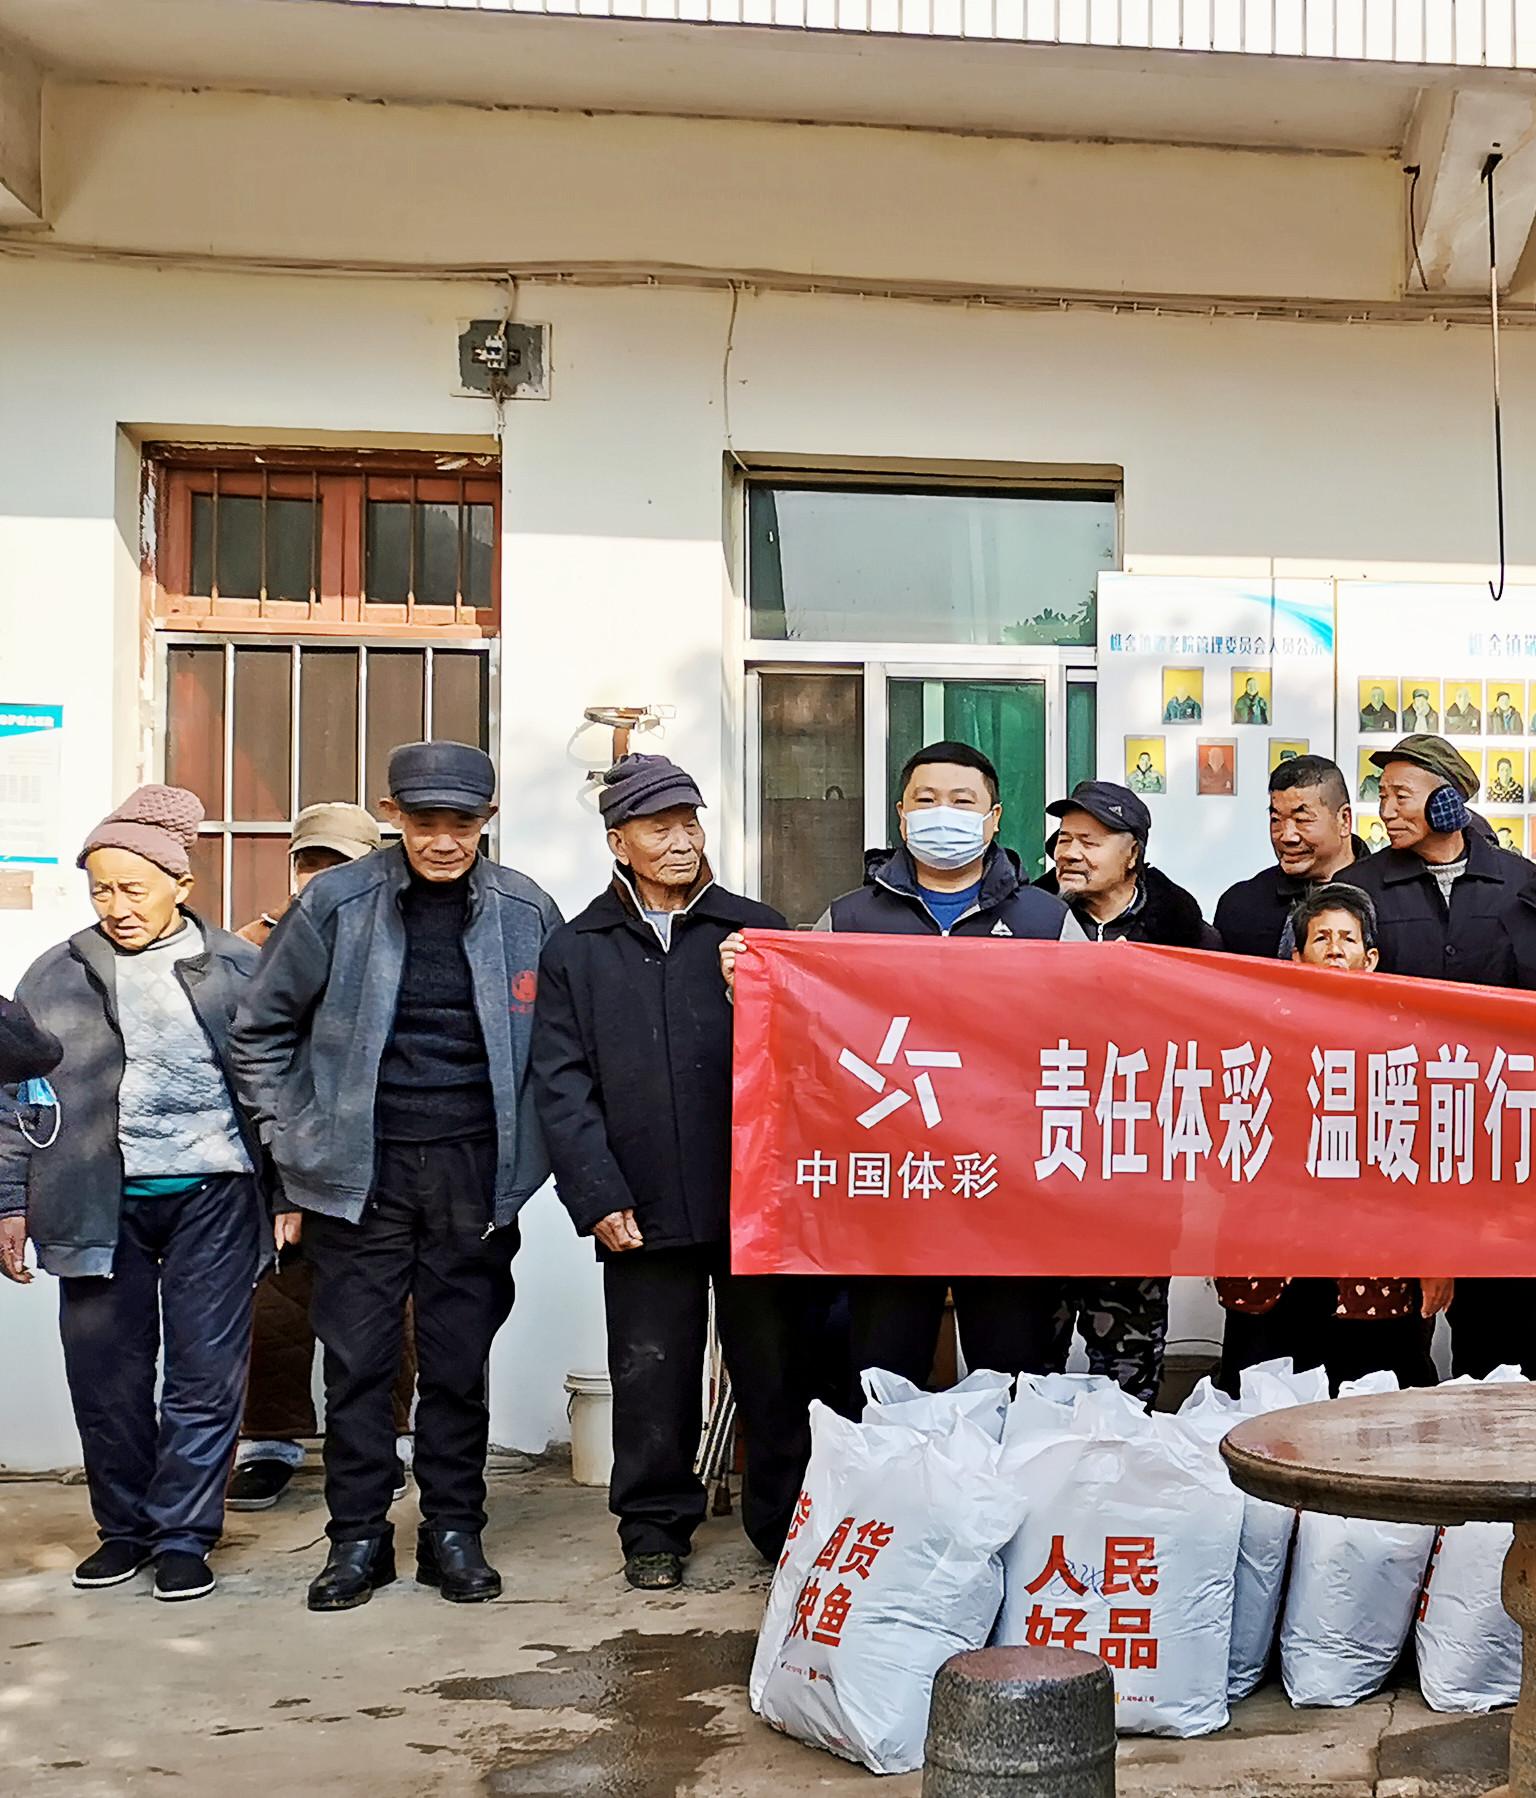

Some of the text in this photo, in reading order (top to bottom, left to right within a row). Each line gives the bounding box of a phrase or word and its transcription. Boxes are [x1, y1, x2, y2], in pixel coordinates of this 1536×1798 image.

[1035, 1039, 1273, 1184] 责任体彩
[796, 1150, 998, 1199] 中国体彩
[1024, 1535, 1159, 1596] 人民
[1025, 1604, 1158, 1669] 好品
